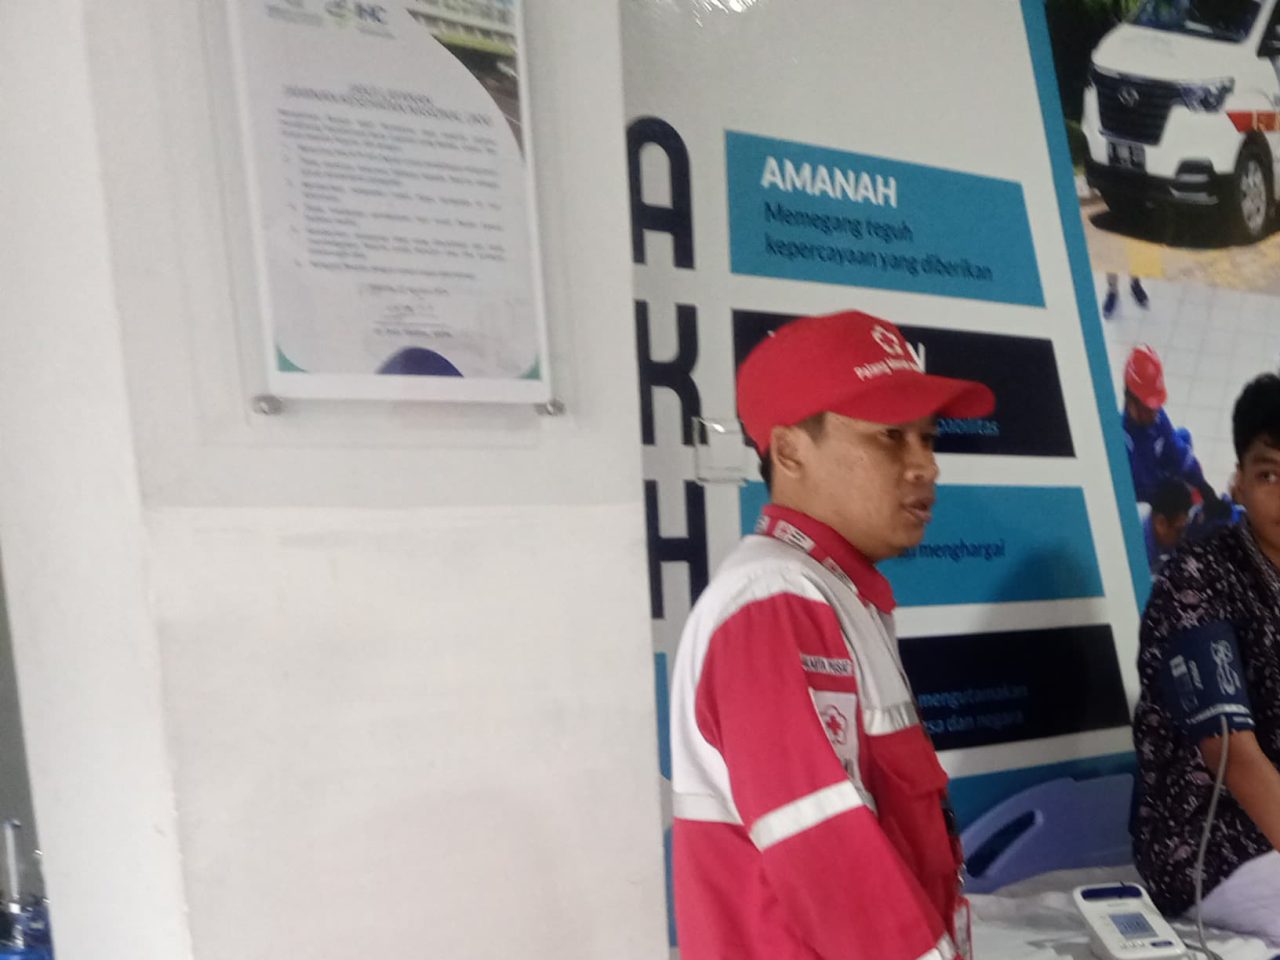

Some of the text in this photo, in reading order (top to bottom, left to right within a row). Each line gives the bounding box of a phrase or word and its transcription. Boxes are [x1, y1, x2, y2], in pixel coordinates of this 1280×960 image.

[760, 155, 898, 208] AMANAH
[764, 200, 914, 244] Memegang teguh
[764, 231, 877, 268] kepercayaan
[920, 252, 994, 282] diberikan
[918, 537, 1006, 563] menghargai
